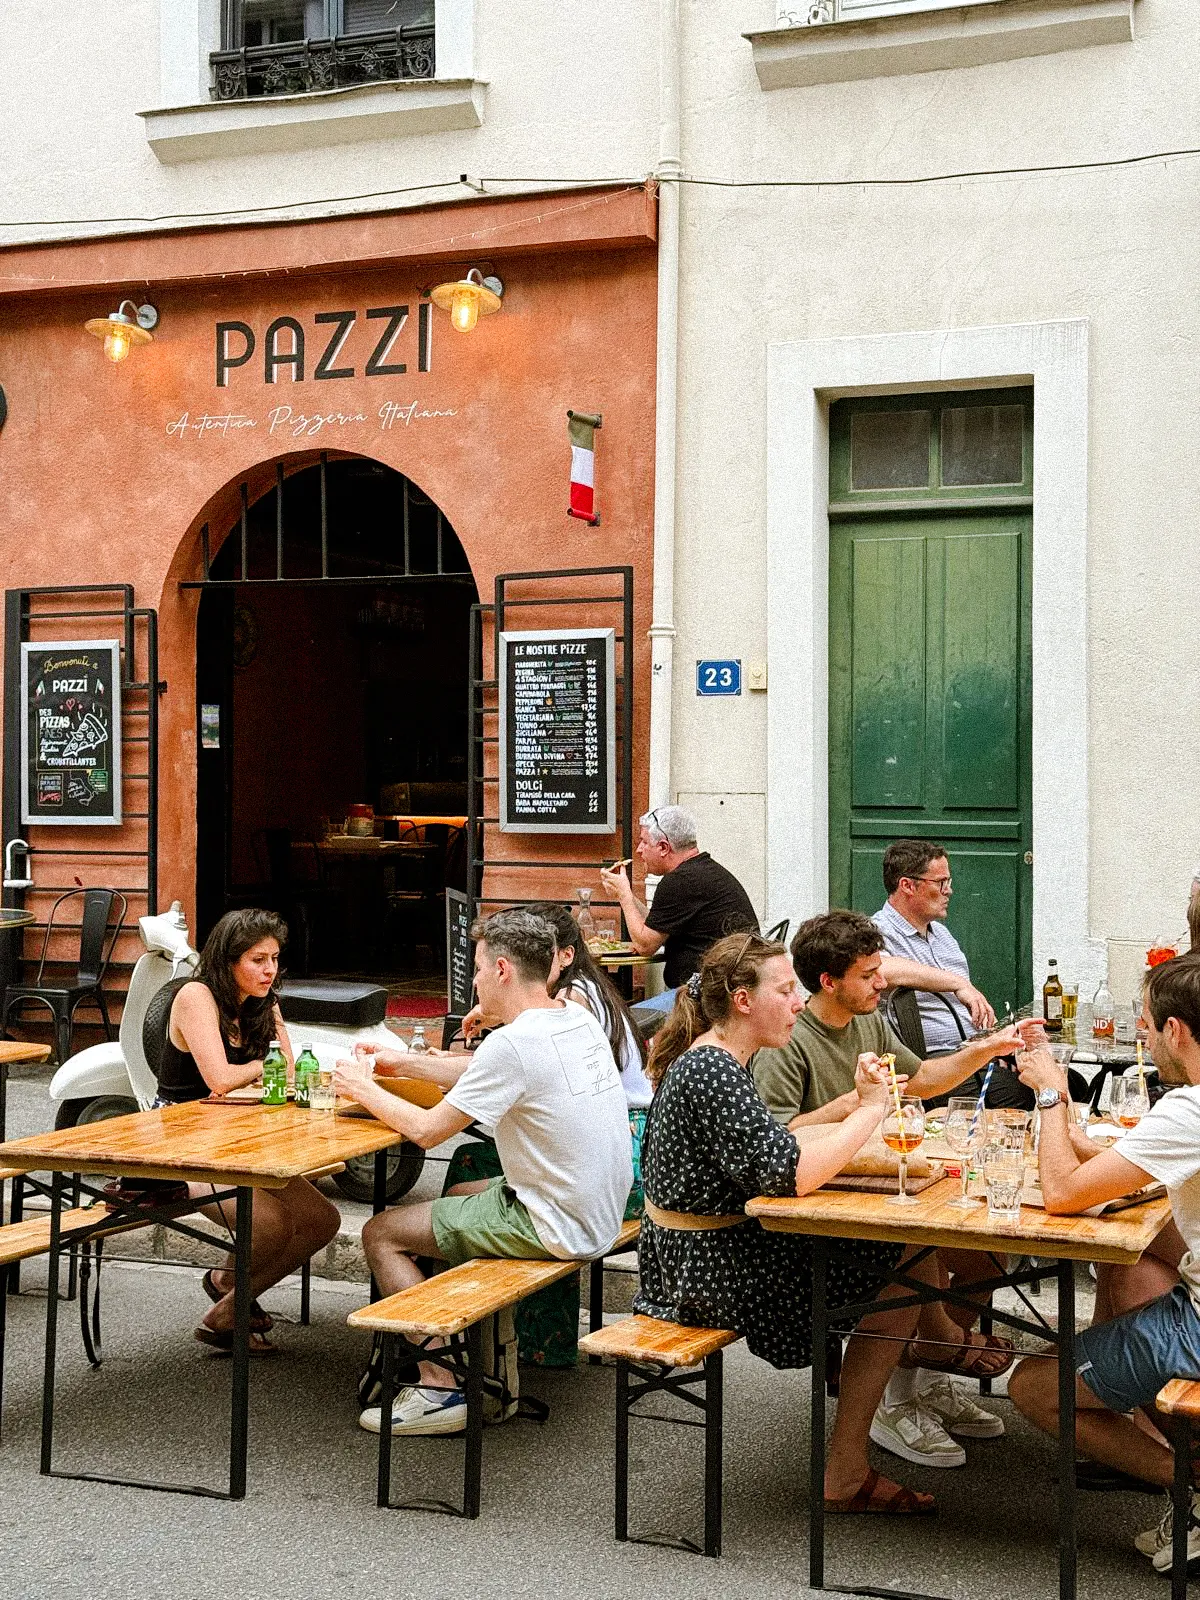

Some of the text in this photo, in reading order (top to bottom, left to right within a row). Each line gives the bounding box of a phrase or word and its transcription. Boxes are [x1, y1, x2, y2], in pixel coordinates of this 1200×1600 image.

[166, 401, 457, 438] Autentica Pizzeria Italiana
[515, 646, 524, 656] LE
[526, 645, 558, 655] NOSTRE
[44, 656, 90, 673] Benvenuti
[705, 668, 732, 687] 23
